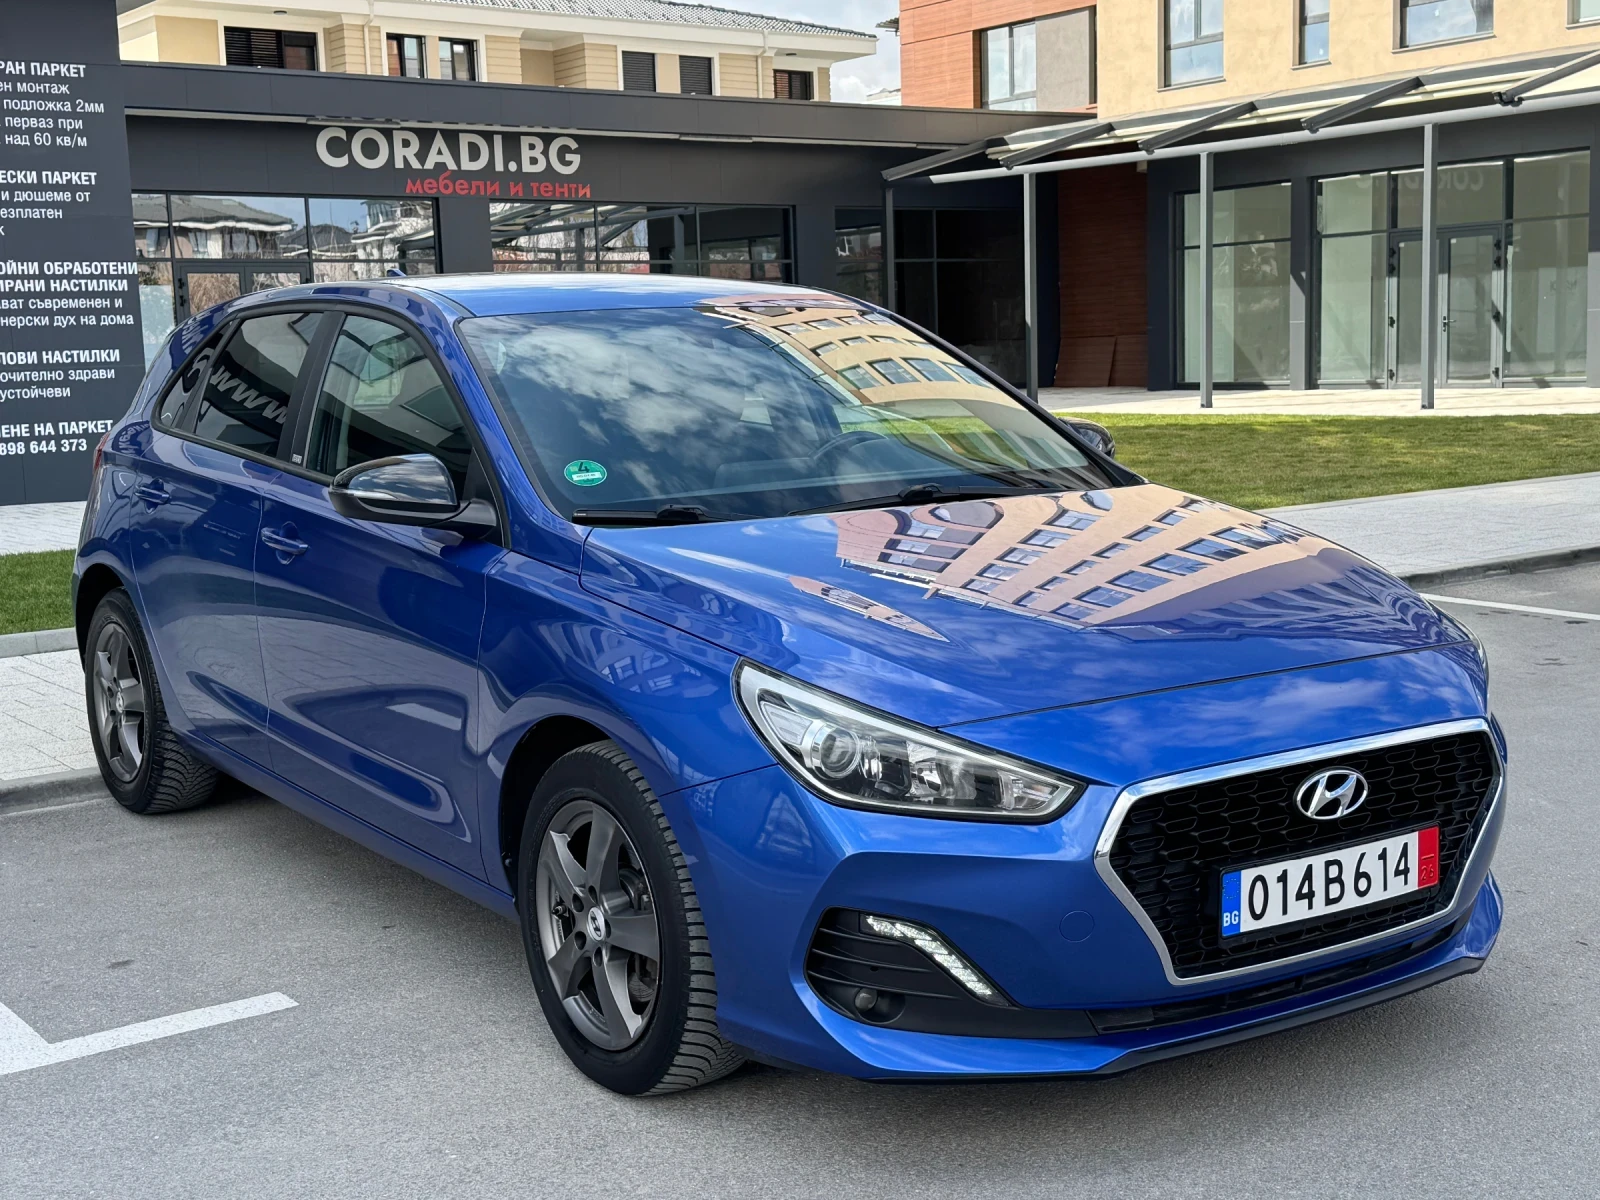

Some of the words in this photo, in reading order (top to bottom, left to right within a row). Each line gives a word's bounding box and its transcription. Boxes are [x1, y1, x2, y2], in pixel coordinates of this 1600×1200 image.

[30, 62, 86, 78] ПАРКЕТ
[16, 82, 70, 94] монтаж
[3, 99, 72, 112] подложка
[75, 99, 105, 113] 2мм
[4, 116, 54, 130] перваз
[58, 118, 83, 132] при
[4, 133, 30, 146] над
[33, 132, 51, 146] 60
[56, 133, 87, 148] кв/м
[315, 126, 581, 175] CORADI.BG
[41, 171, 97, 185] ПАРКЕТ
[405, 170, 500, 196] мебели
[509, 181, 523, 197] и
[530, 182, 591, 198] тенти
[13, 190, 72, 202] дюшеме
[75, 191, 91, 202] от
[0, 207, 63, 219] езплатен
[43, 261, 138, 275] ОБРАБОТЕНИ
[50, 279, 128, 292] НАСТИЛКИ
[0, 298, 24, 309] ват
[28, 298, 110, 311] съвременен
[114, 298, 123, 308] и
[53, 315, 76, 328] дух
[80, 315, 97, 325] на
[100, 314, 134, 326] дома
[42, 349, 120, 364] НАСТИЛКИ
[68, 368, 115, 382] здрави
[0, 385, 71, 402] устойчеви
[0, 423, 30, 438] ЕНЕ
[34, 422, 55, 436] НА
[58, 420, 113, 435] ПАРКЕТ
[29, 440, 57, 454] 644
[60, 438, 87, 452] 373
[578, 461, 590, 472] 4
[1248, 841, 1410, 921] 014B614
[1223, 910, 1239, 927] BG
